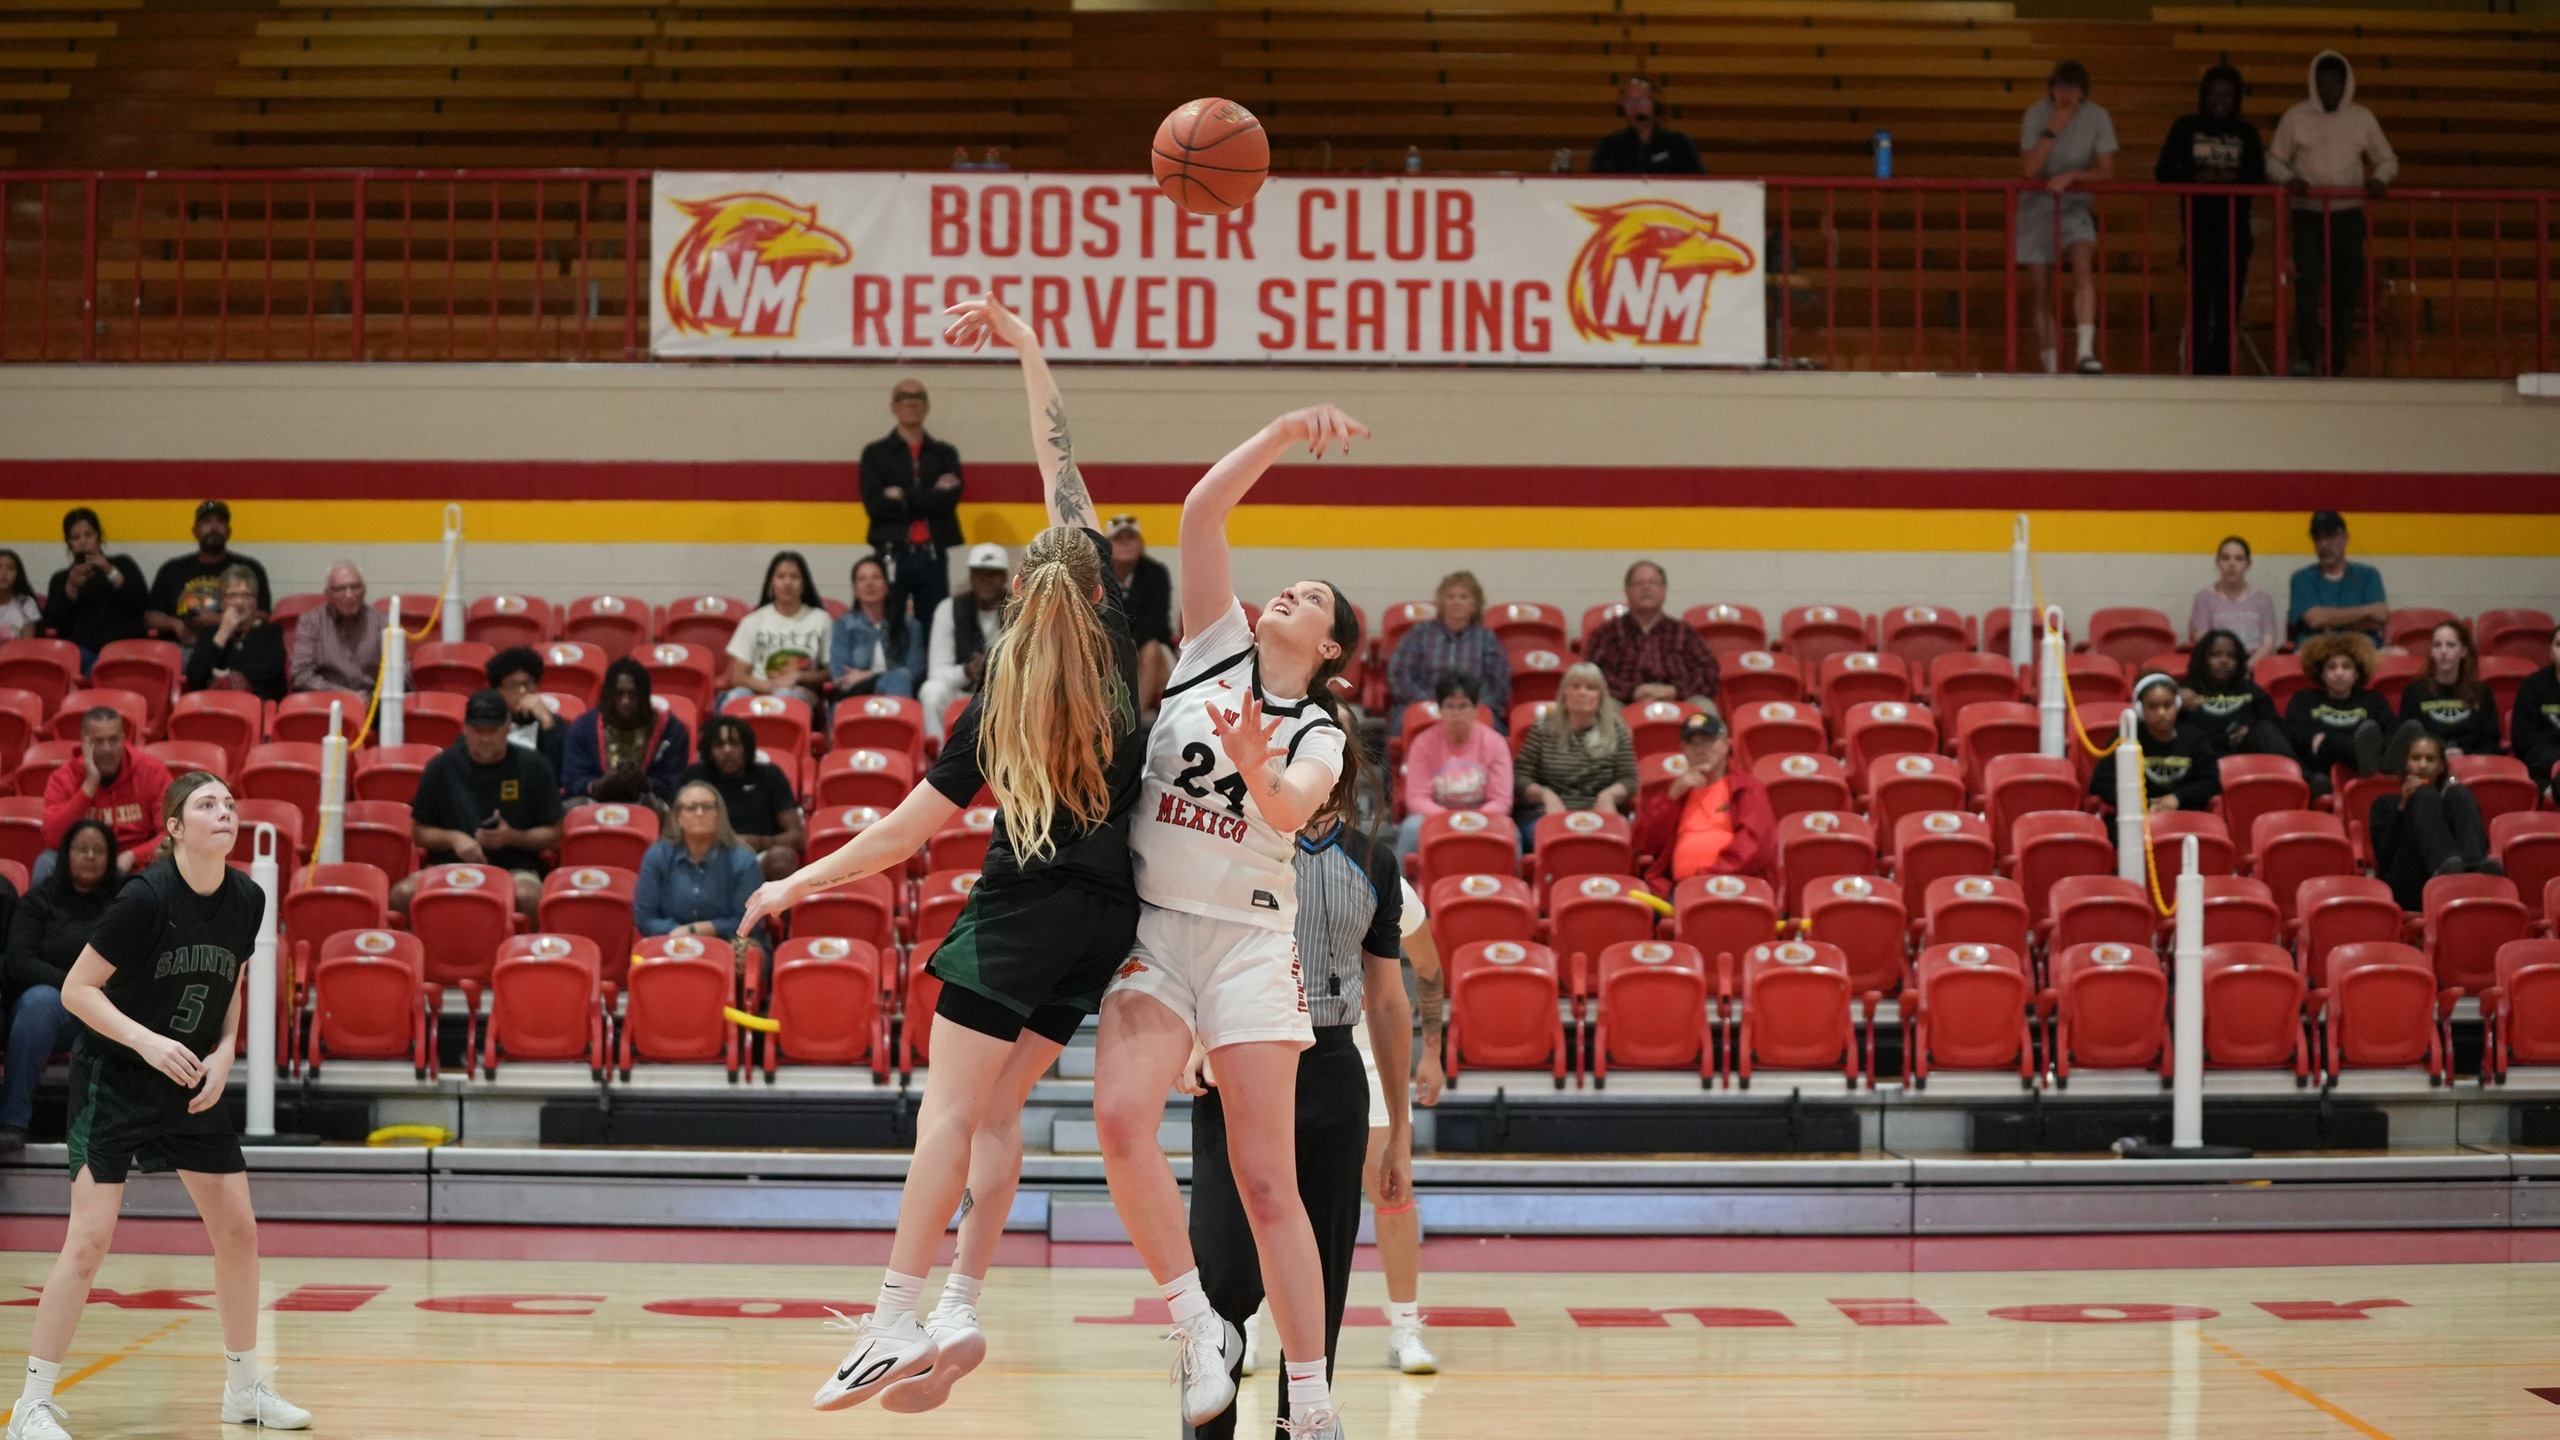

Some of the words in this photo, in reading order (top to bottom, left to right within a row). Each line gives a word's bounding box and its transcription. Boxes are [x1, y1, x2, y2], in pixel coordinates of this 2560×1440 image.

[930, 184, 1255, 260] BOOSTER
[1298, 188, 1475, 262] CLUB
[697, 249, 806, 334] NM
[1257, 278, 1552, 353] SEATING
[1601, 256, 1709, 342] NM
[1155, 791, 1249, 844] MEXICO
[1173, 741, 1249, 819] 24
[154, 944, 237, 982] SAINTS
[169, 984, 210, 1034] 5
